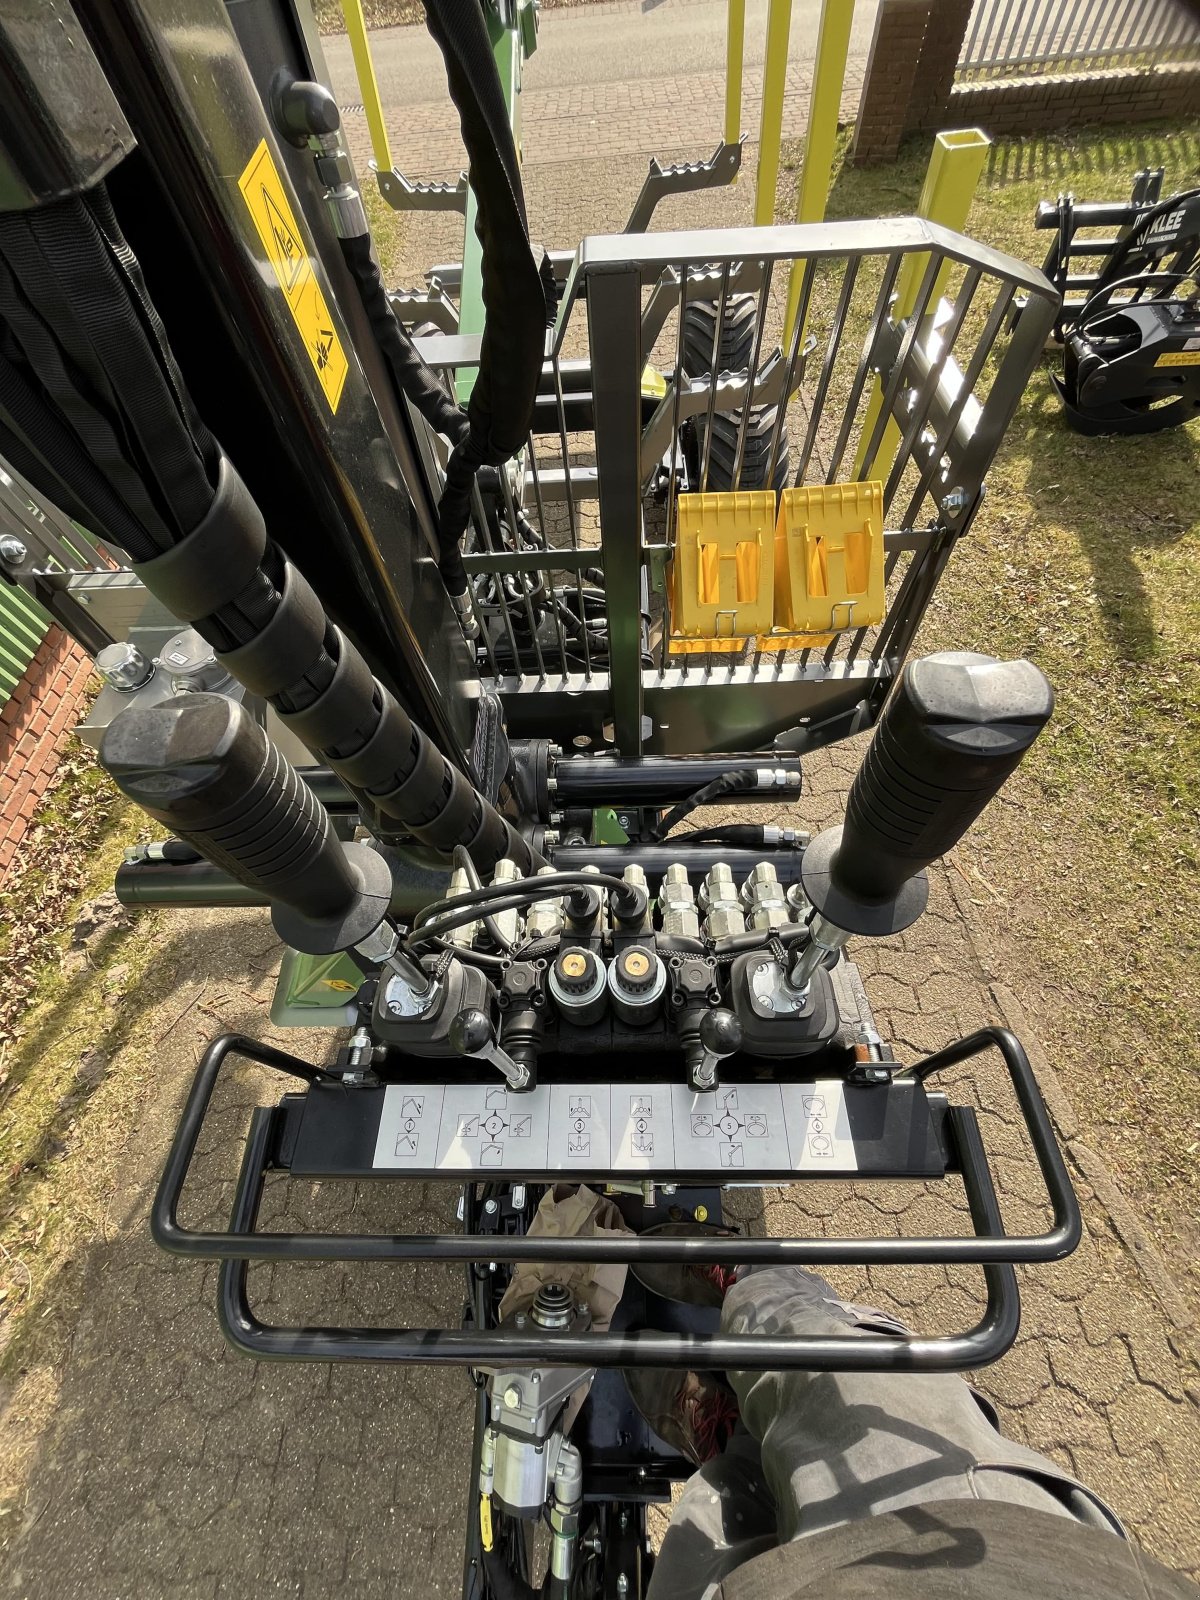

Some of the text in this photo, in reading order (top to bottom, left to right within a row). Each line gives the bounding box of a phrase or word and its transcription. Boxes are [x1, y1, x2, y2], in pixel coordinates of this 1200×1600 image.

[1149, 209, 1187, 234] KLEE
[491, 1122, 497, 1130] 2
[577, 1122, 582, 1130] 3
[639, 1122, 644, 1130] 4
[727, 1122, 732, 1130] 5
